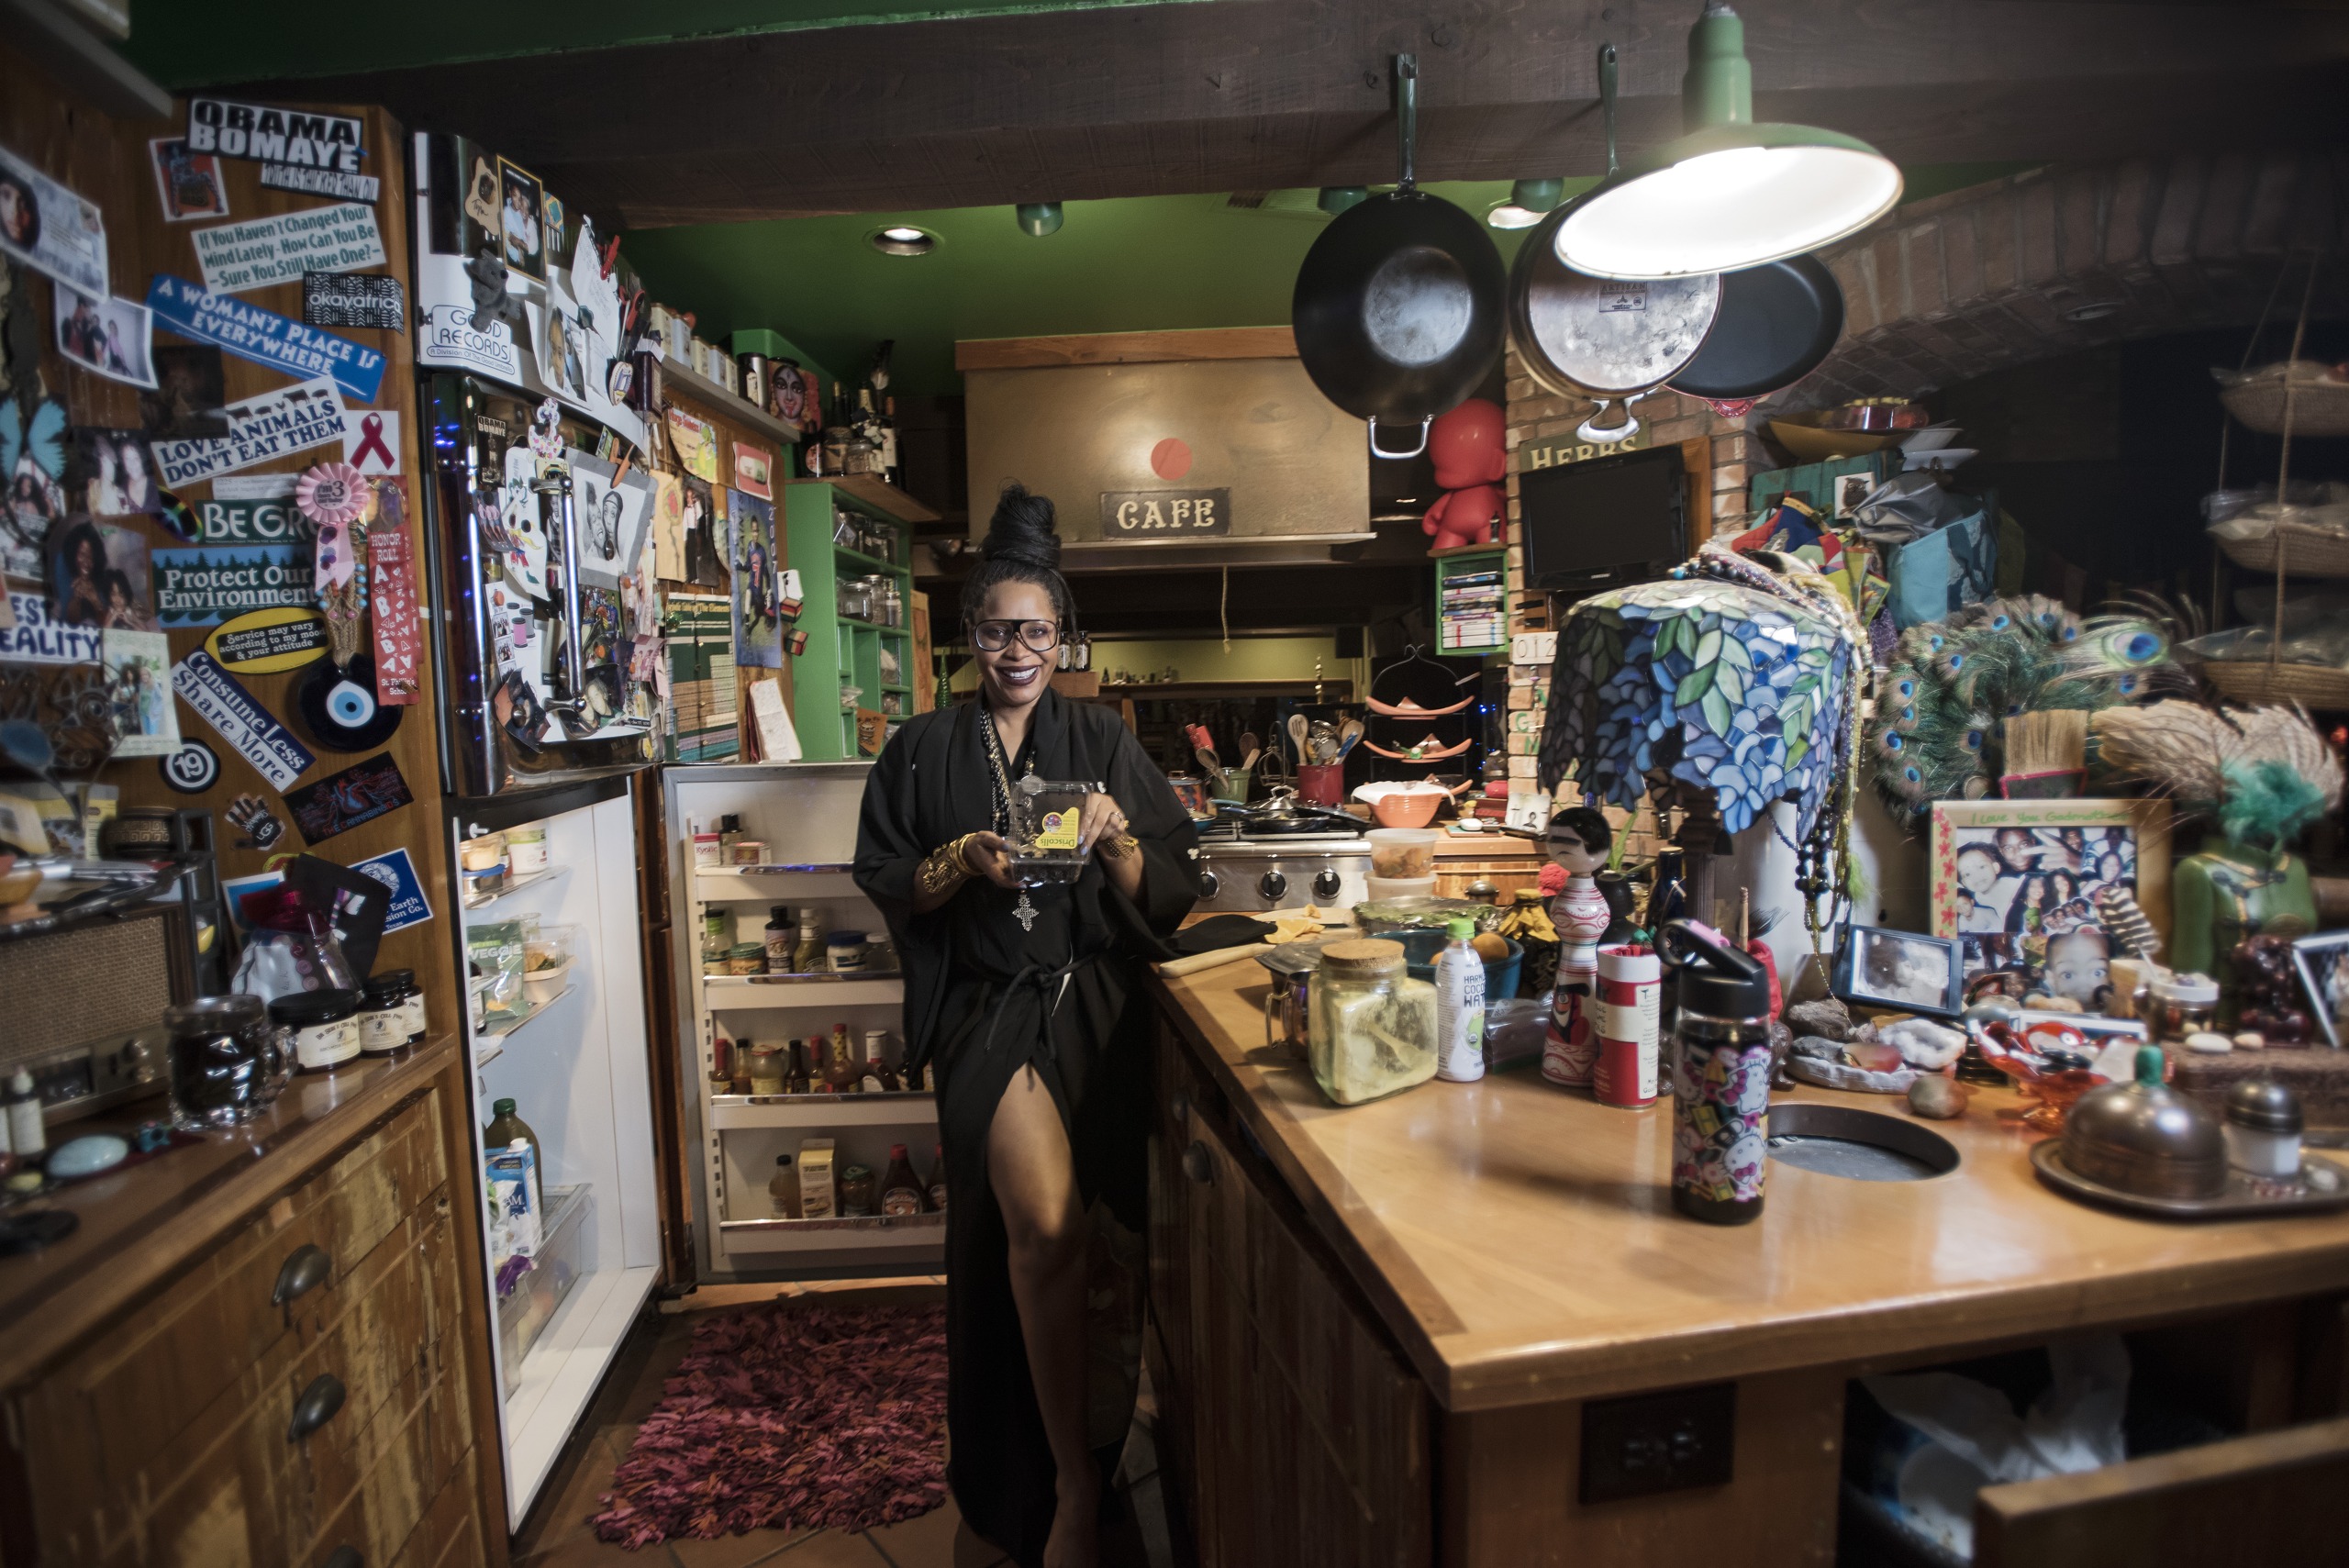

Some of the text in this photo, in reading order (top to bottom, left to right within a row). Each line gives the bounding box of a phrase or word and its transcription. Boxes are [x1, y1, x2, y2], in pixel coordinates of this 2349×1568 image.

[195, 101, 356, 145] OBAMA
[190, 126, 359, 170] BOMAYE
[199, 206, 368, 250] If You Haven't Changed Your
[204, 250, 236, 269] Mind
[281, 238, 306, 254] How
[308, 233, 333, 249] Can
[333, 228, 357, 244] You
[358, 224, 375, 239] Be
[250, 263, 276, 281] You
[276, 257, 305, 276] Still
[306, 255, 339, 272] Have
[309, 294, 404, 315] okayafrica
[158, 279, 381, 369] A WOMAN'S PLACE IS
[191, 311, 336, 374] EVERYWHERE
[440, 328, 507, 360] RECORDS
[160, 438, 224, 464] LOVE
[229, 399, 336, 445] ANIMALS
[478, 417, 506, 429] OBAMA
[478, 423, 506, 437] BOMAYE
[164, 449, 232, 484] DON'T
[236, 435, 279, 462] EAT
[284, 416, 347, 447] THEM
[332, 480, 344, 496] 3
[1116, 498, 1216, 530] CAFE
[371, 533, 401, 546] HONOR
[377, 549, 398, 562] ROLL
[164, 566, 310, 590] Protect Our
[158, 587, 318, 608] Environment
[219, 628, 326, 653] according to my mood
[227, 622, 314, 644] Service may vary
[237, 639, 313, 661] & your attitude
[187, 651, 267, 732] Consume
[262, 723, 306, 770] Less
[172, 670, 235, 733] Share
[235, 728, 285, 783] More
[175, 752, 204, 779] 19
[323, 799, 400, 836] THE CANNABINOIDS
[1980, 813, 2009, 824] Love
[2016, 812, 2041, 825] You
[256, 823, 274, 840] UGG
[696, 846, 718, 855] Kyolic
[390, 896, 418, 912] Earth
[408, 905, 423, 914] Co.
[386, 920, 403, 929] Texas
